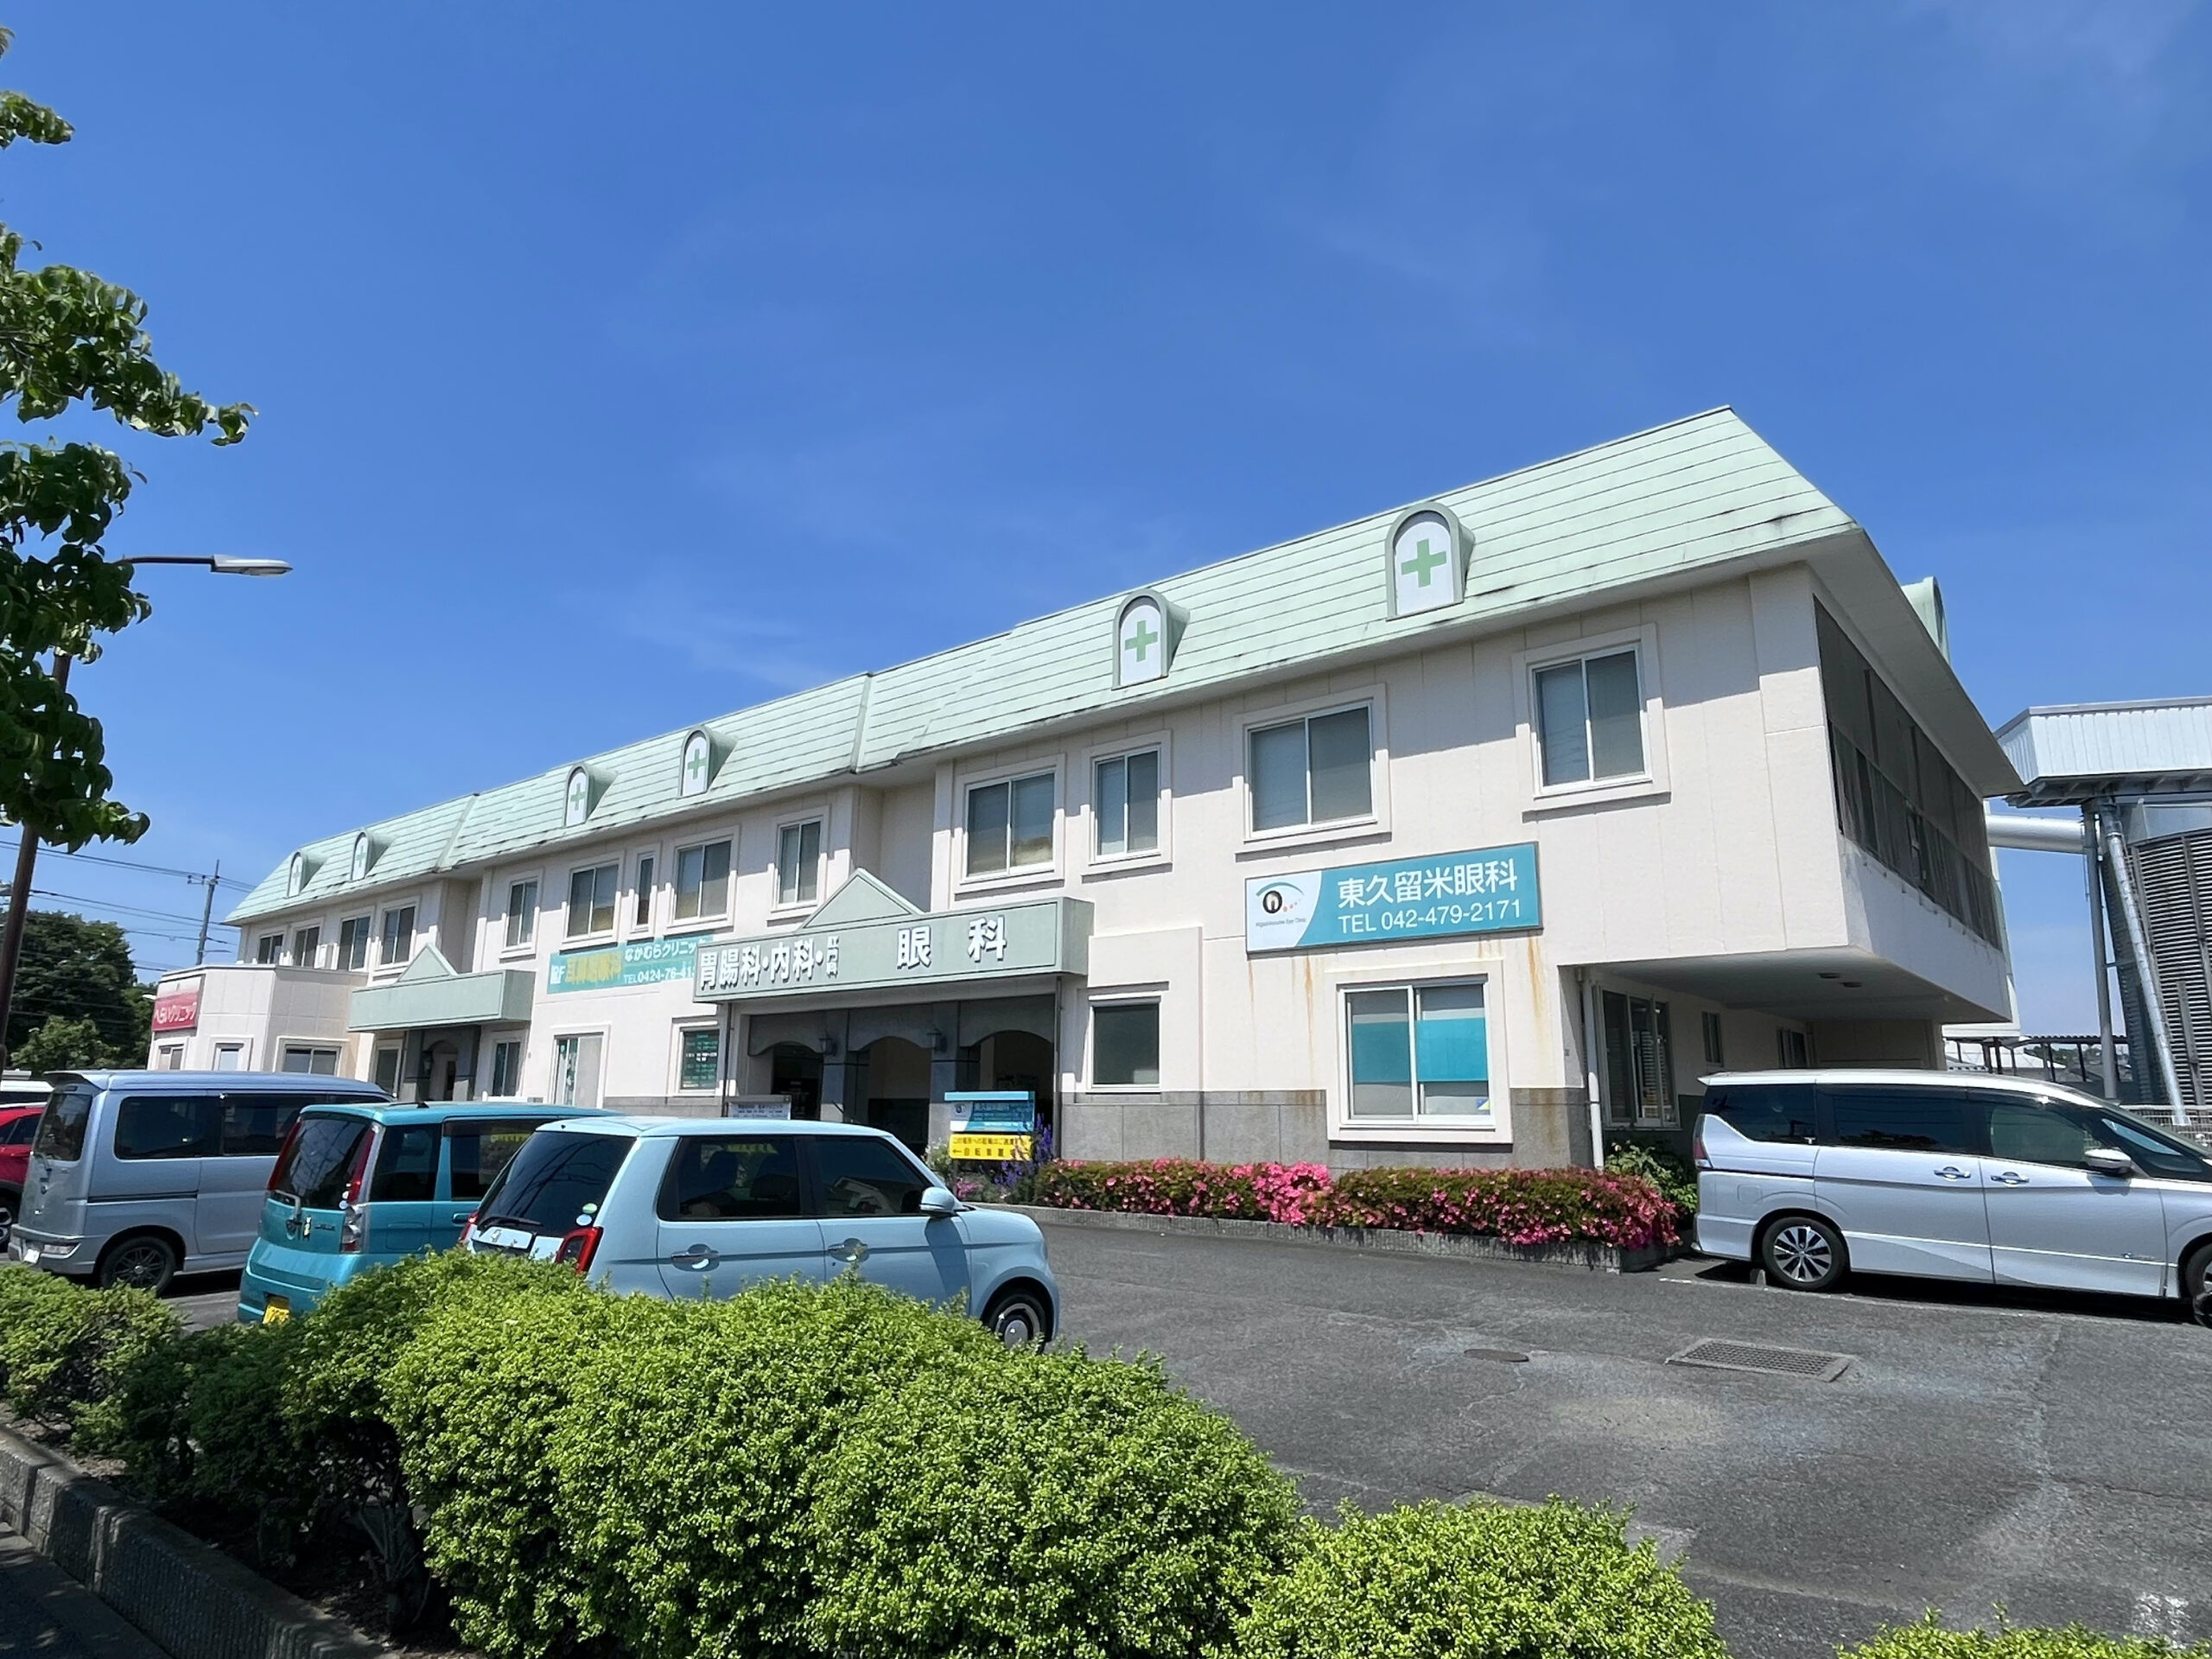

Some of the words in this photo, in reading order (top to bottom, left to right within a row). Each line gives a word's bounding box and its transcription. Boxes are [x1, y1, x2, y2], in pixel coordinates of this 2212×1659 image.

[1338, 859, 1517, 909] 東久留米眼科
[1338, 914, 1376, 934] TEL
[1381, 899, 1520, 930] 042-479-2171
